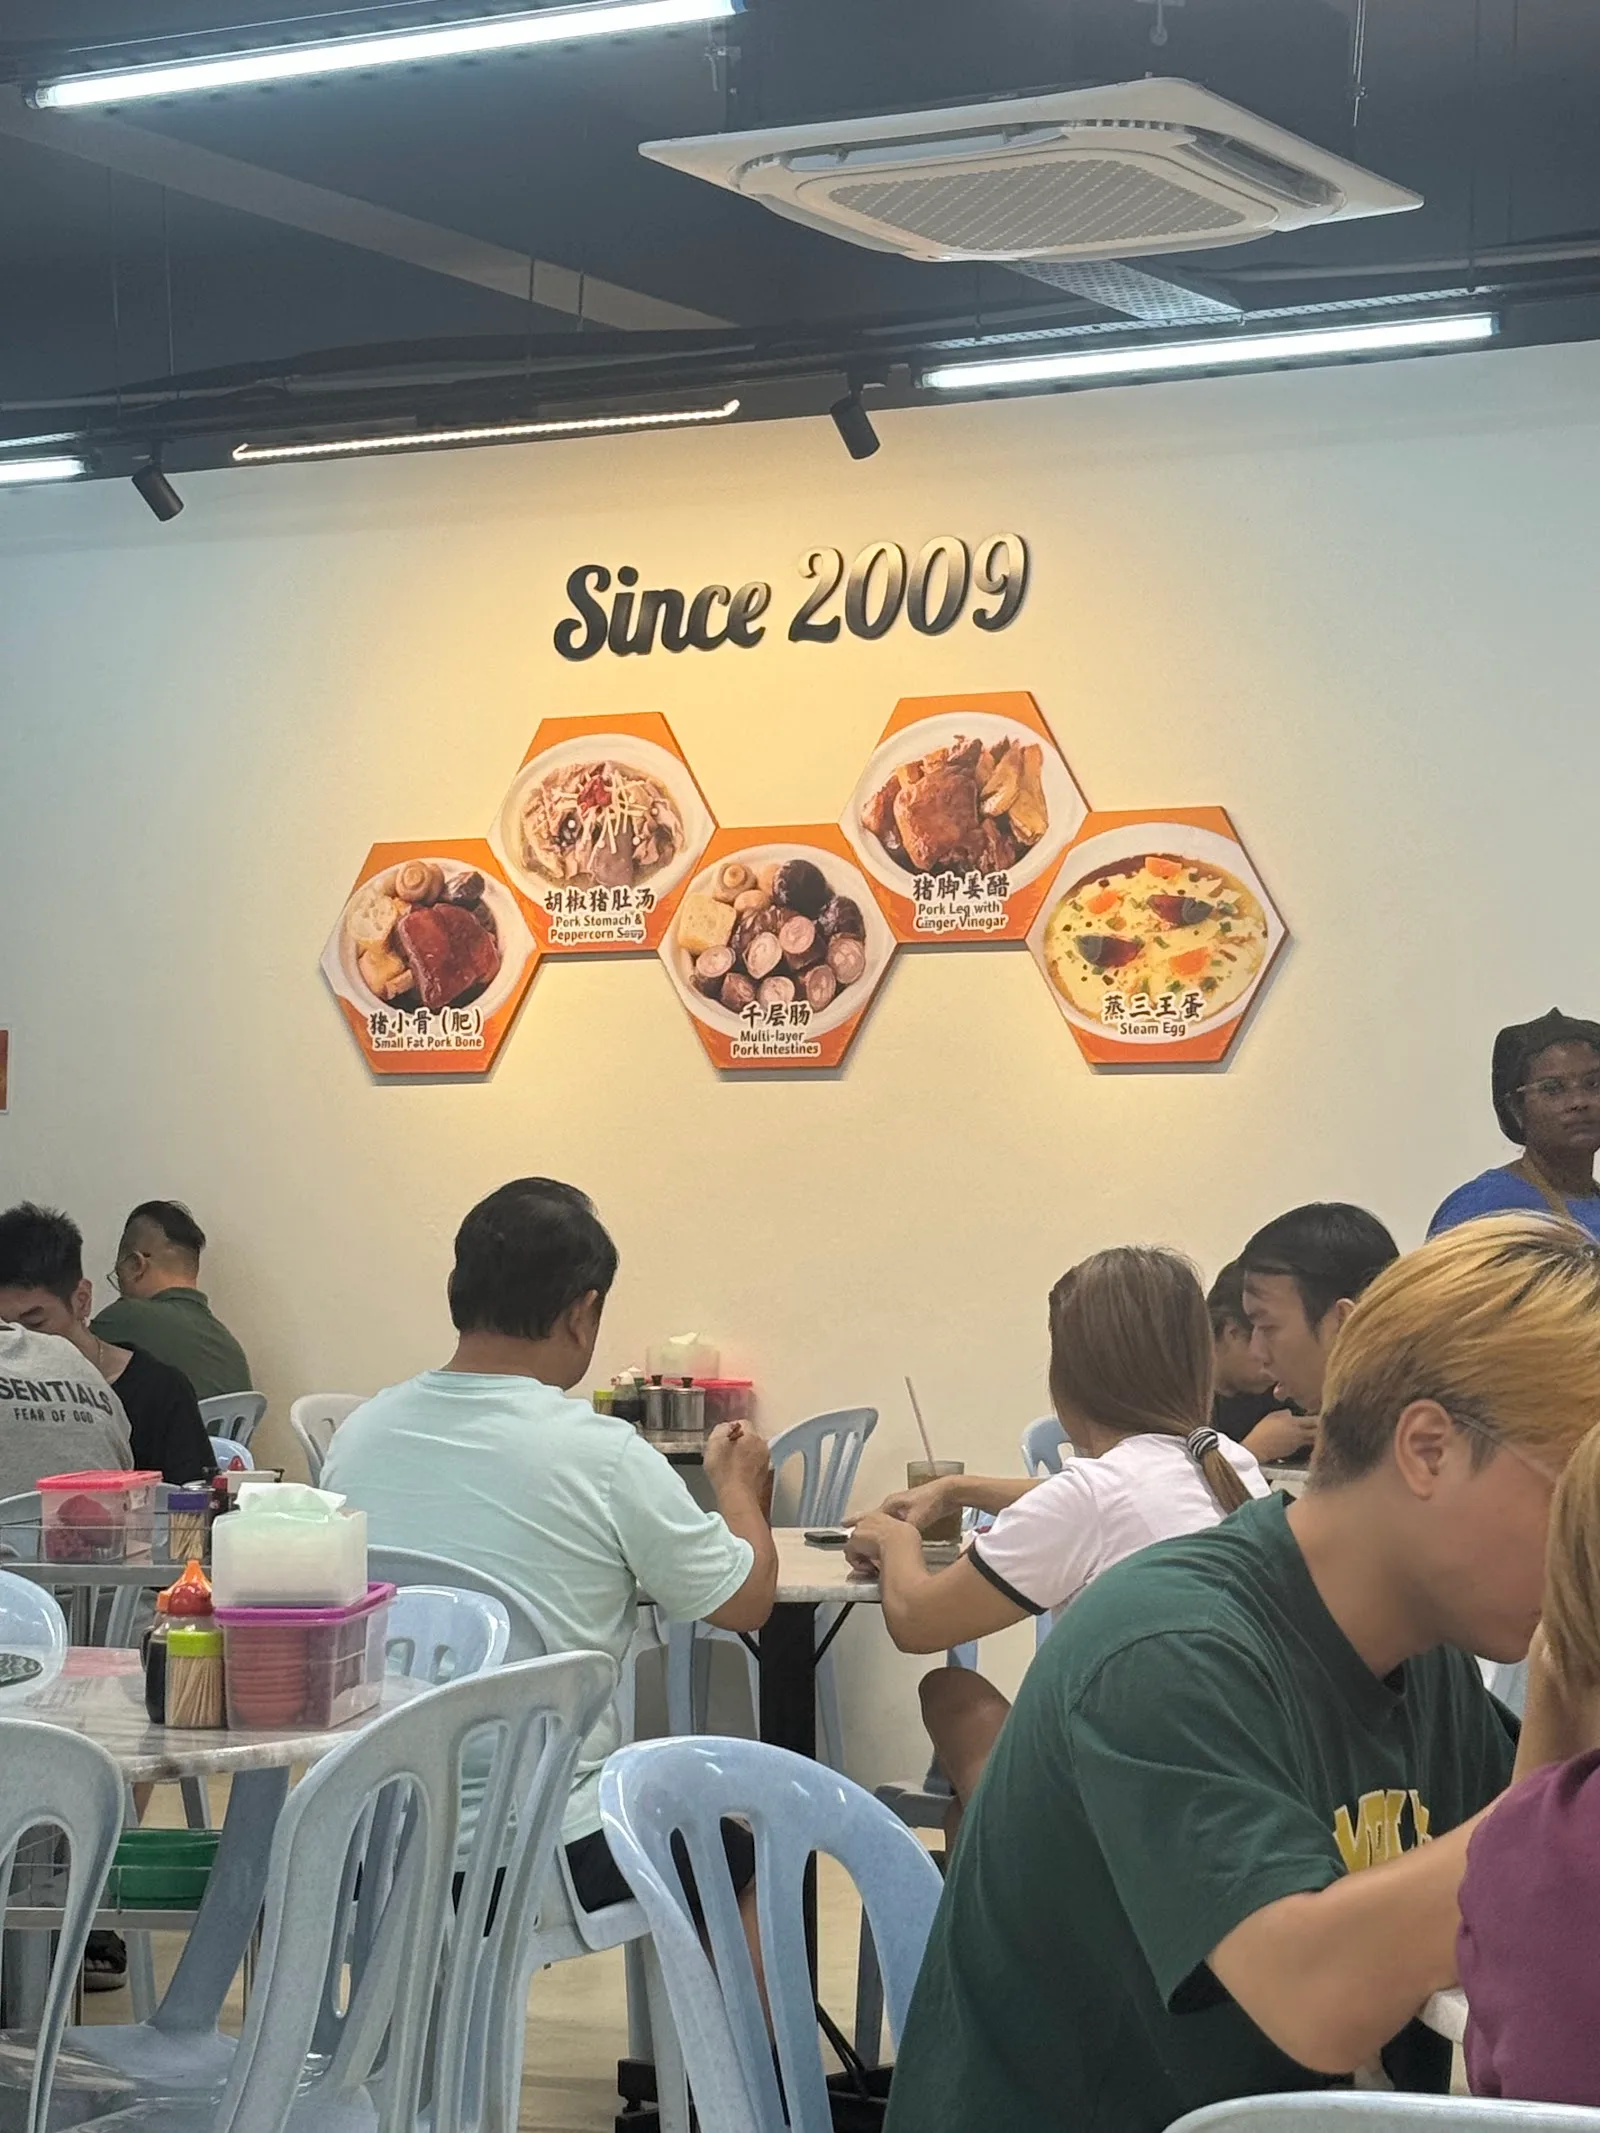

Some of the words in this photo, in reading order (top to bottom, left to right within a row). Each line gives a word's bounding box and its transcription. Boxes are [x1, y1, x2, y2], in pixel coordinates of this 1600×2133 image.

[554, 564, 772, 662] Since
[788, 532, 1031, 642] 2009
[913, 873, 1010, 901] 猪脚姜醋
[544, 887, 655, 914] 胡椒猪肚汤
[918, 904, 946, 915] Pork
[949, 903, 970, 917] Leg
[973, 901, 1000, 914] with
[555, 916, 581, 927] Pork
[583, 913, 631, 926] Stomach
[634, 913, 642, 924] &
[915, 917, 956, 931] Ginger
[959, 916, 1006, 929] Vinegar
[550, 929, 614, 942] Peppercorn
[617, 927, 644, 940] Soup
[1104, 992, 1204, 1020] 蒸三王蛋
[741, 1003, 811, 1029] 千层肠
[740, 1030, 805, 1044] Multi-layer
[1120, 1023, 1159, 1035] Steam
[1163, 1022, 1186, 1037] Egg
[374, 1038, 404, 1049] Small
[407, 1037, 424, 1048] Fat
[427, 1037, 452, 1047] Pork
[455, 1036, 482, 1047] Bone
[733, 1043, 760, 1056] Pork
[763, 1042, 819, 1055] Intestines
[13, 1407, 45, 1422] FEAR
[51, 1409, 66, 1422] OF
[72, 1410, 94, 1424] GOD
